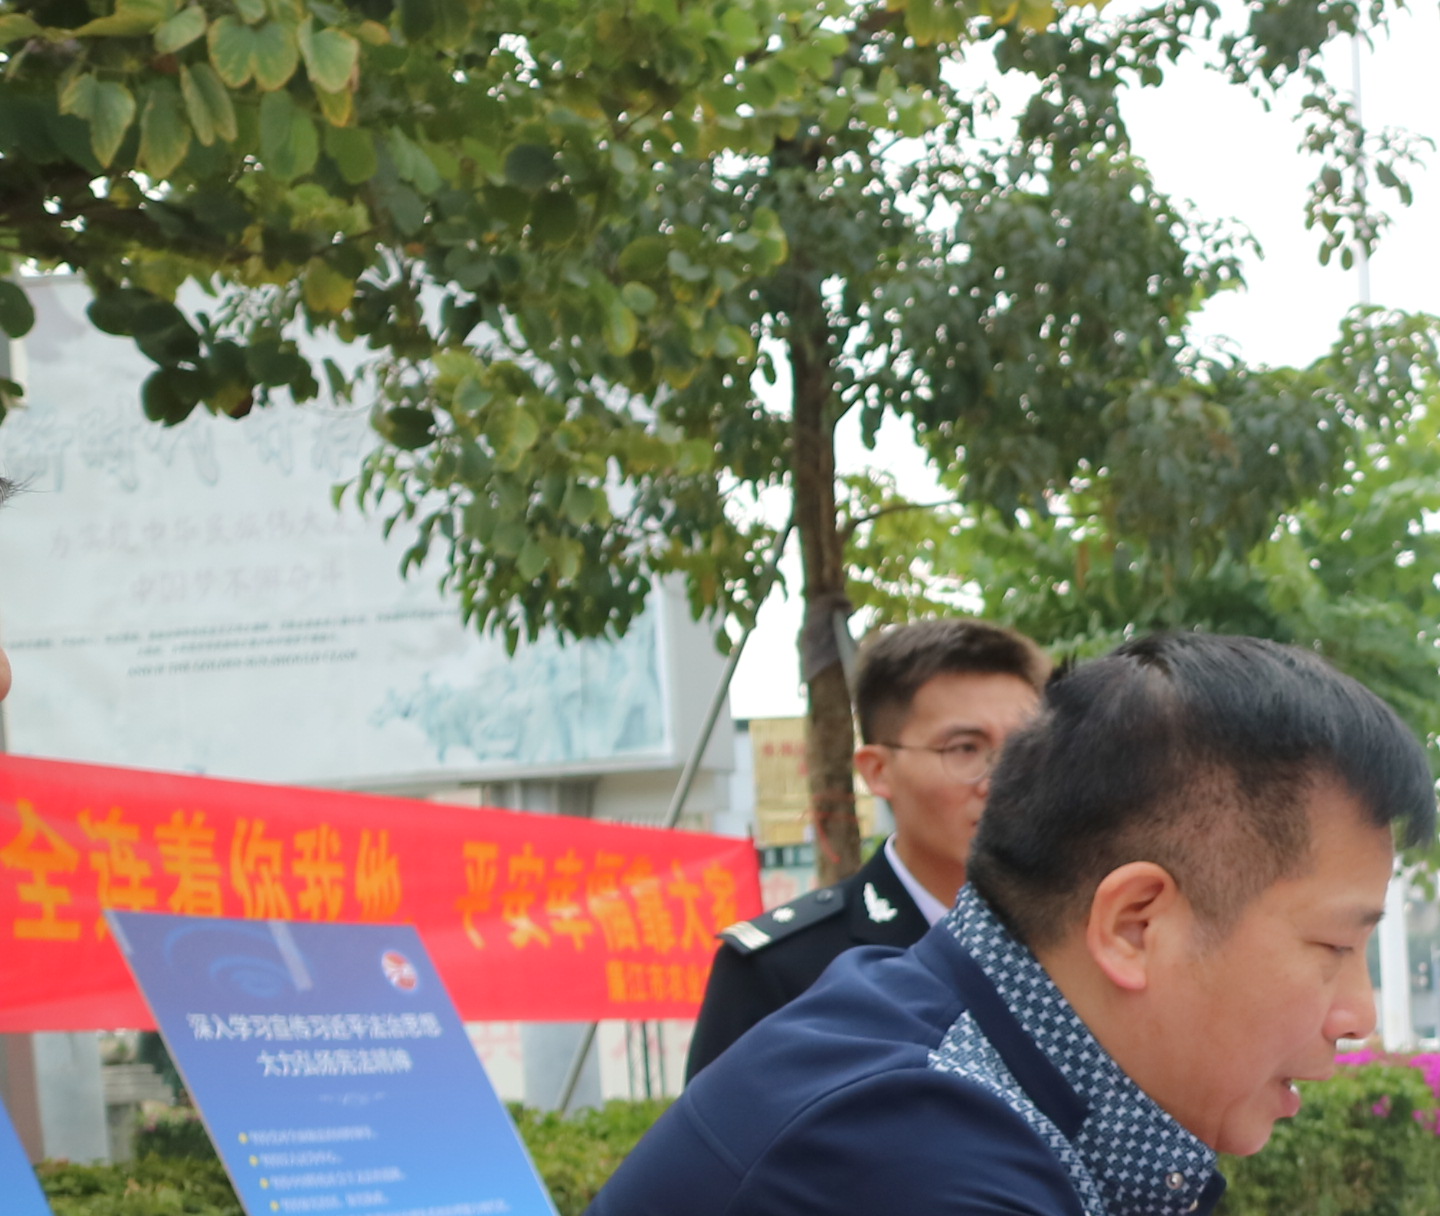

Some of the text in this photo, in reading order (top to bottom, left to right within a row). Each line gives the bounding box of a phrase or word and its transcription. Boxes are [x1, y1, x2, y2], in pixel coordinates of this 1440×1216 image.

[456, 840, 738, 954] 平安幸福靠大家
